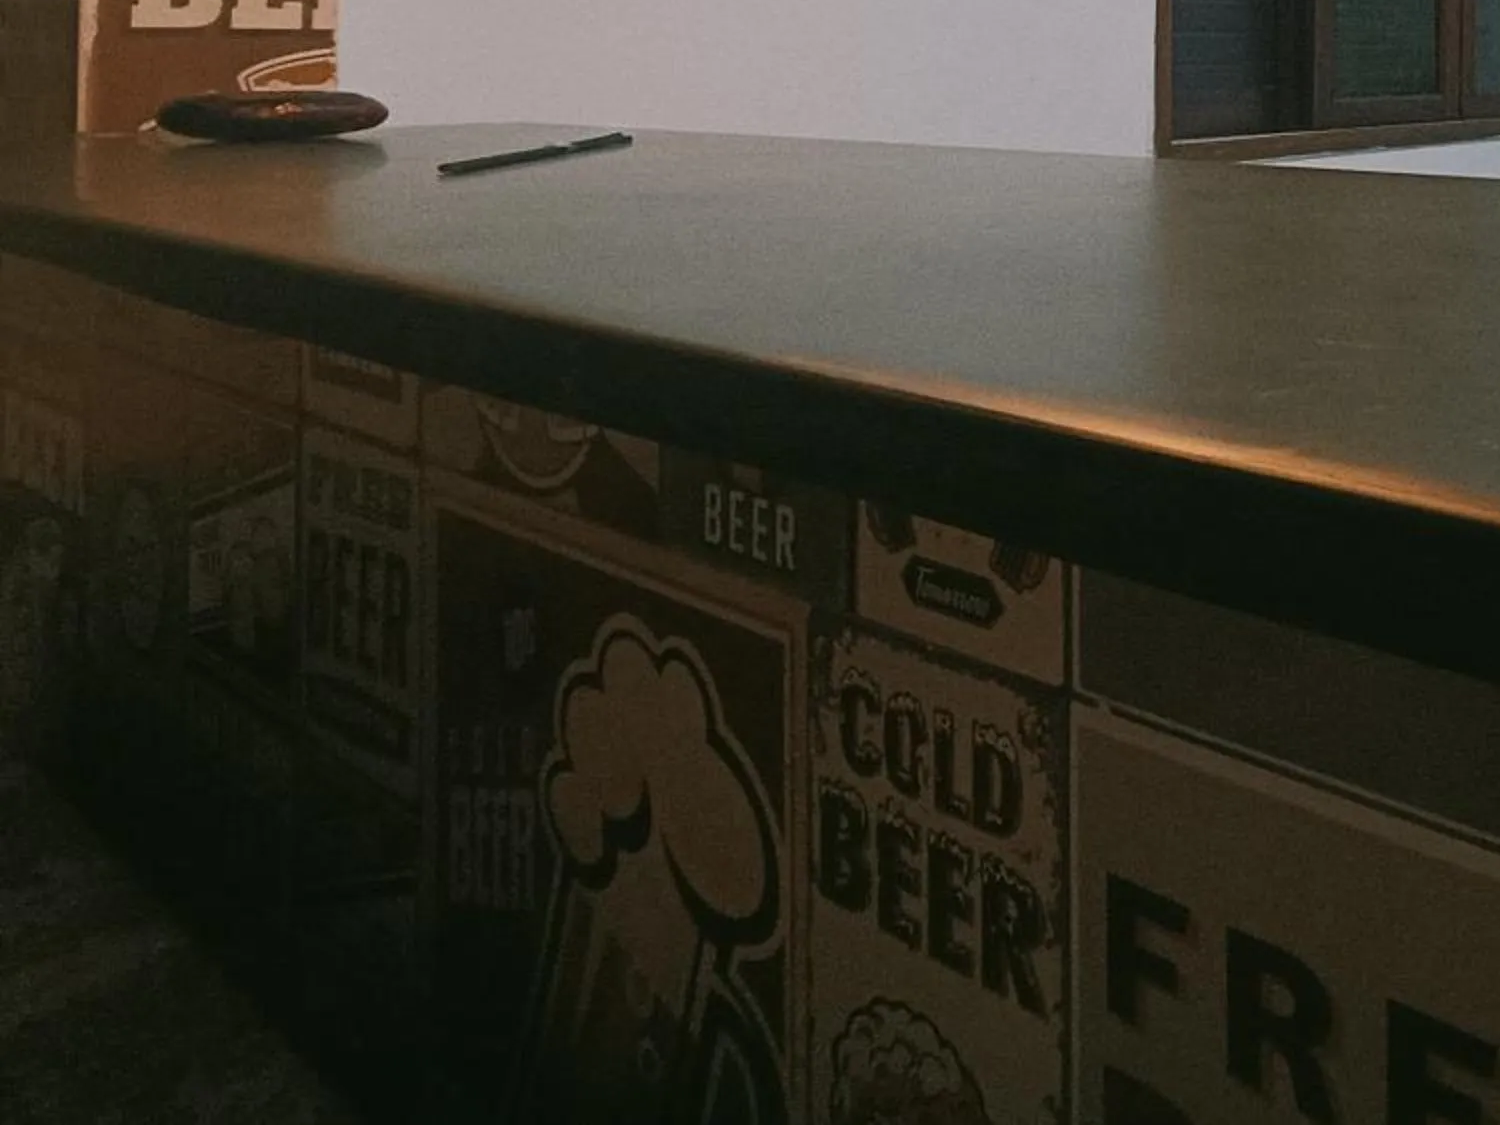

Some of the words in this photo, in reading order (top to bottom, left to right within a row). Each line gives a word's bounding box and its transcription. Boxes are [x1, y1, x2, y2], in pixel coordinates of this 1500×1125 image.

[703, 482, 797, 572] BEER
[835, 673, 1024, 839] COLD
[817, 778, 1056, 1020] BEER
